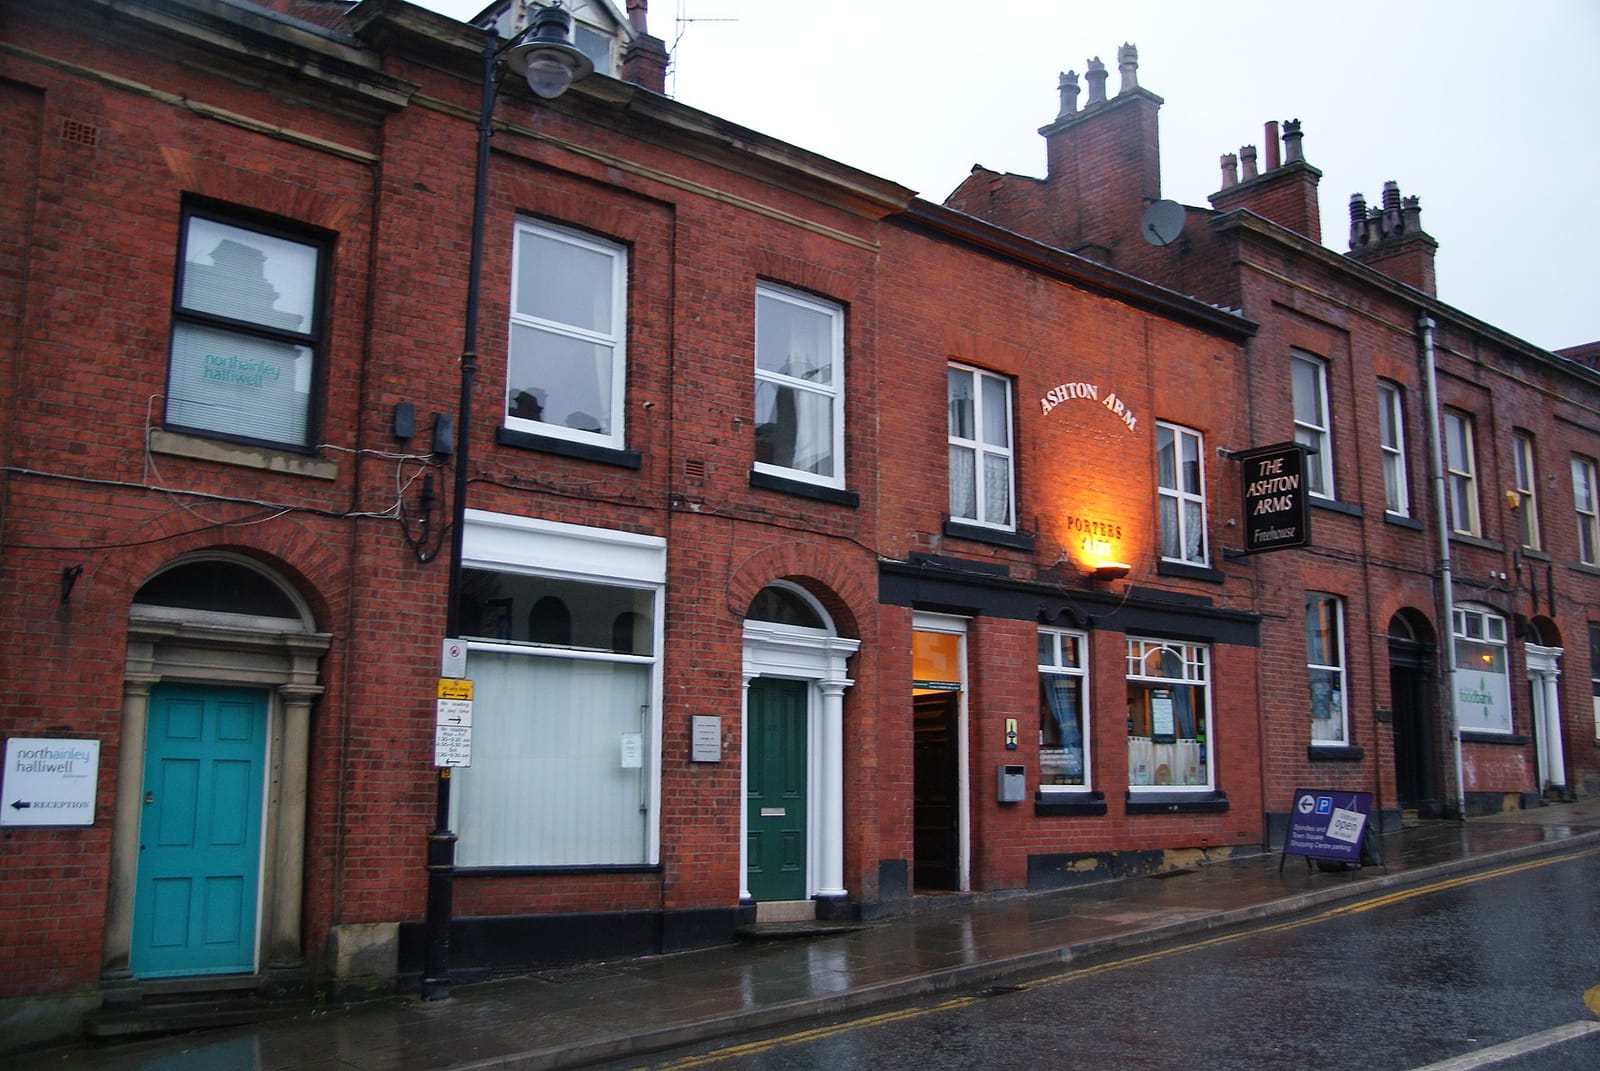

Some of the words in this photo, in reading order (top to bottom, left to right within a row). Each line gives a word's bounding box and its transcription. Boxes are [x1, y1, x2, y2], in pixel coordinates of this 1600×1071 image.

[1040, 383, 1098, 416] ASHTON
[1102, 393, 1137, 431] ARM
[1259, 458, 1284, 477] THE
[1246, 474, 1299, 498] ASHTON
[1253, 494, 1293, 515] ARMS
[1067, 515, 1122, 539] PORTERS
[1253, 525, 1296, 543] Freehouse
[17, 747, 90, 763] northainley
[16, 760, 73, 773] halliwell
[32, 801, 89, 809] RECEPTION
[1320, 800, 1329, 811] P
[1335, 819, 1357, 832] open
